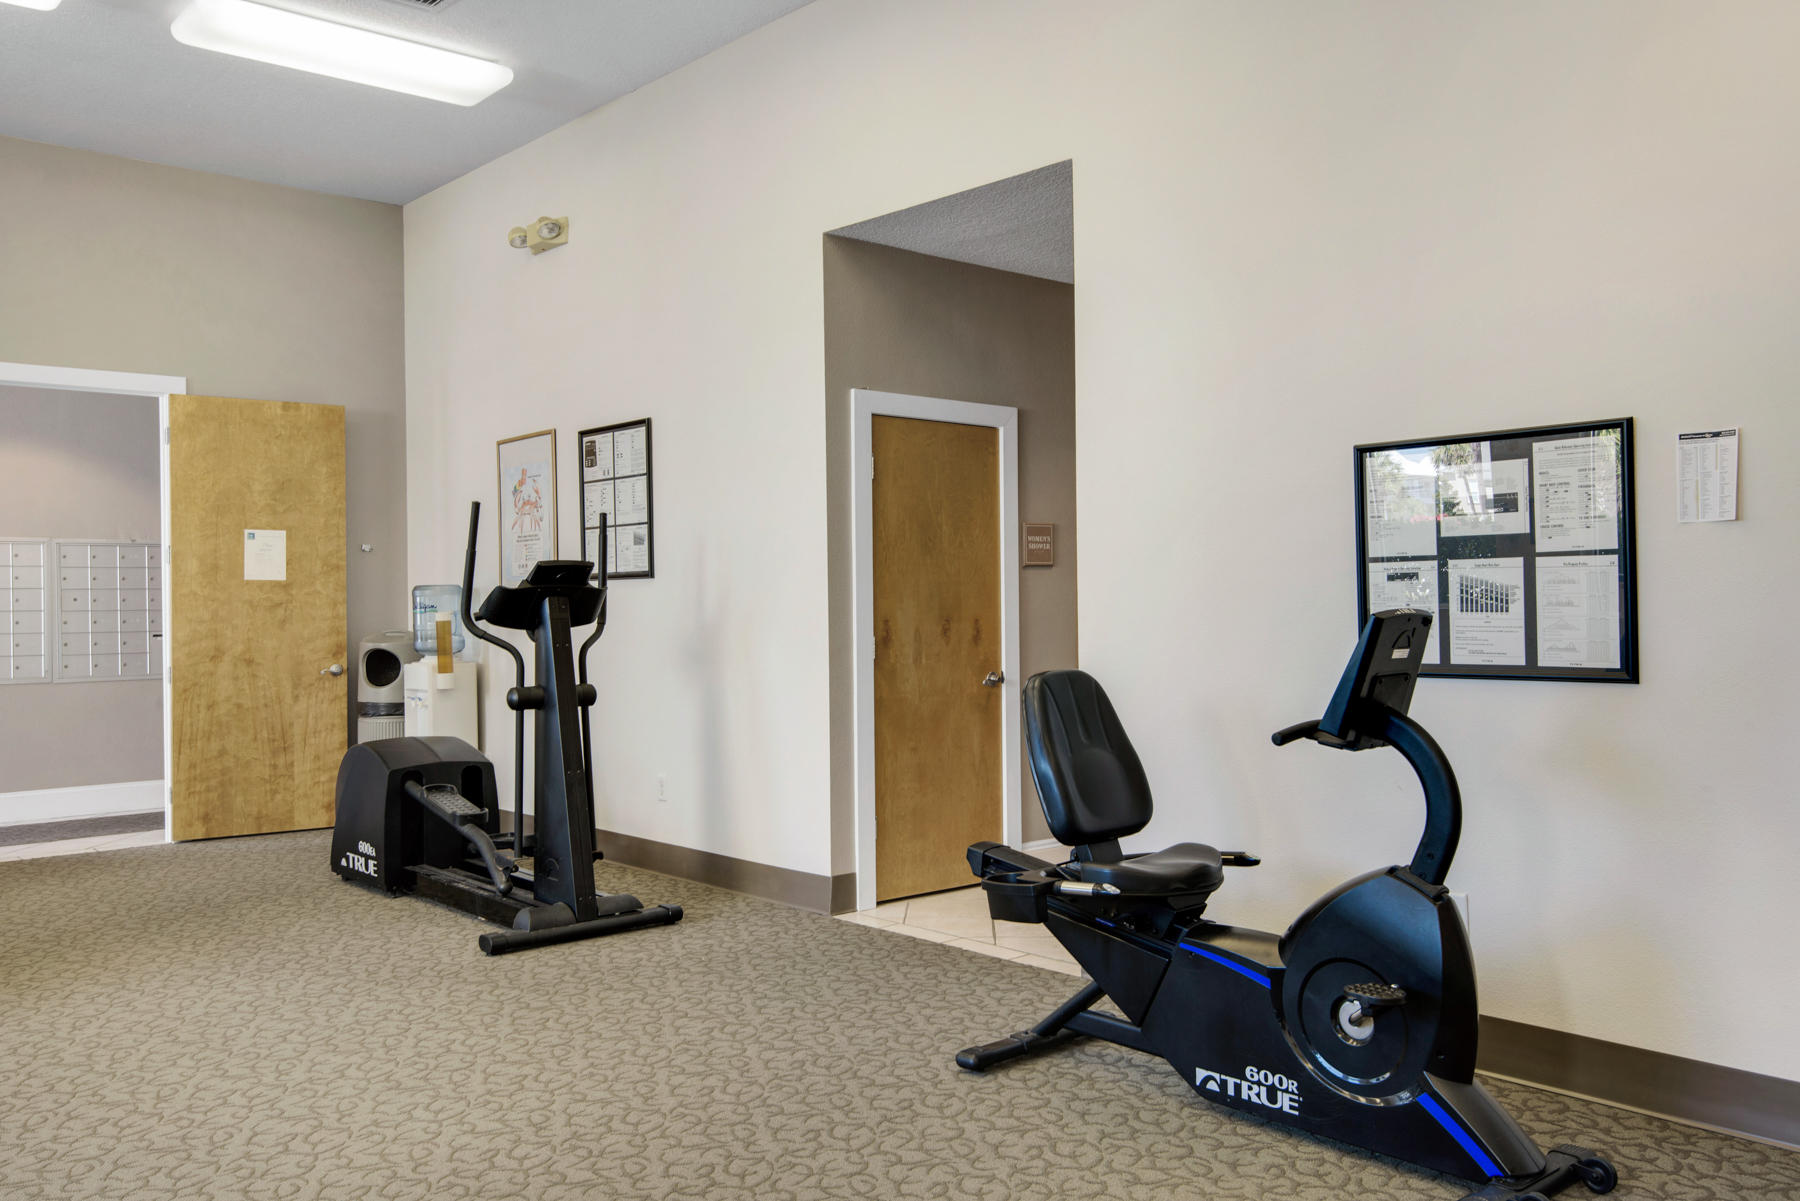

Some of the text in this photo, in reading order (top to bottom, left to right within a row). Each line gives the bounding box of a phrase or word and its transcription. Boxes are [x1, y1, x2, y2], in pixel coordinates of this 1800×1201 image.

[346, 852, 378, 877] TRUE
[1245, 1065, 1299, 1094] 600R
[1220, 1074, 1299, 1116] TRUE
